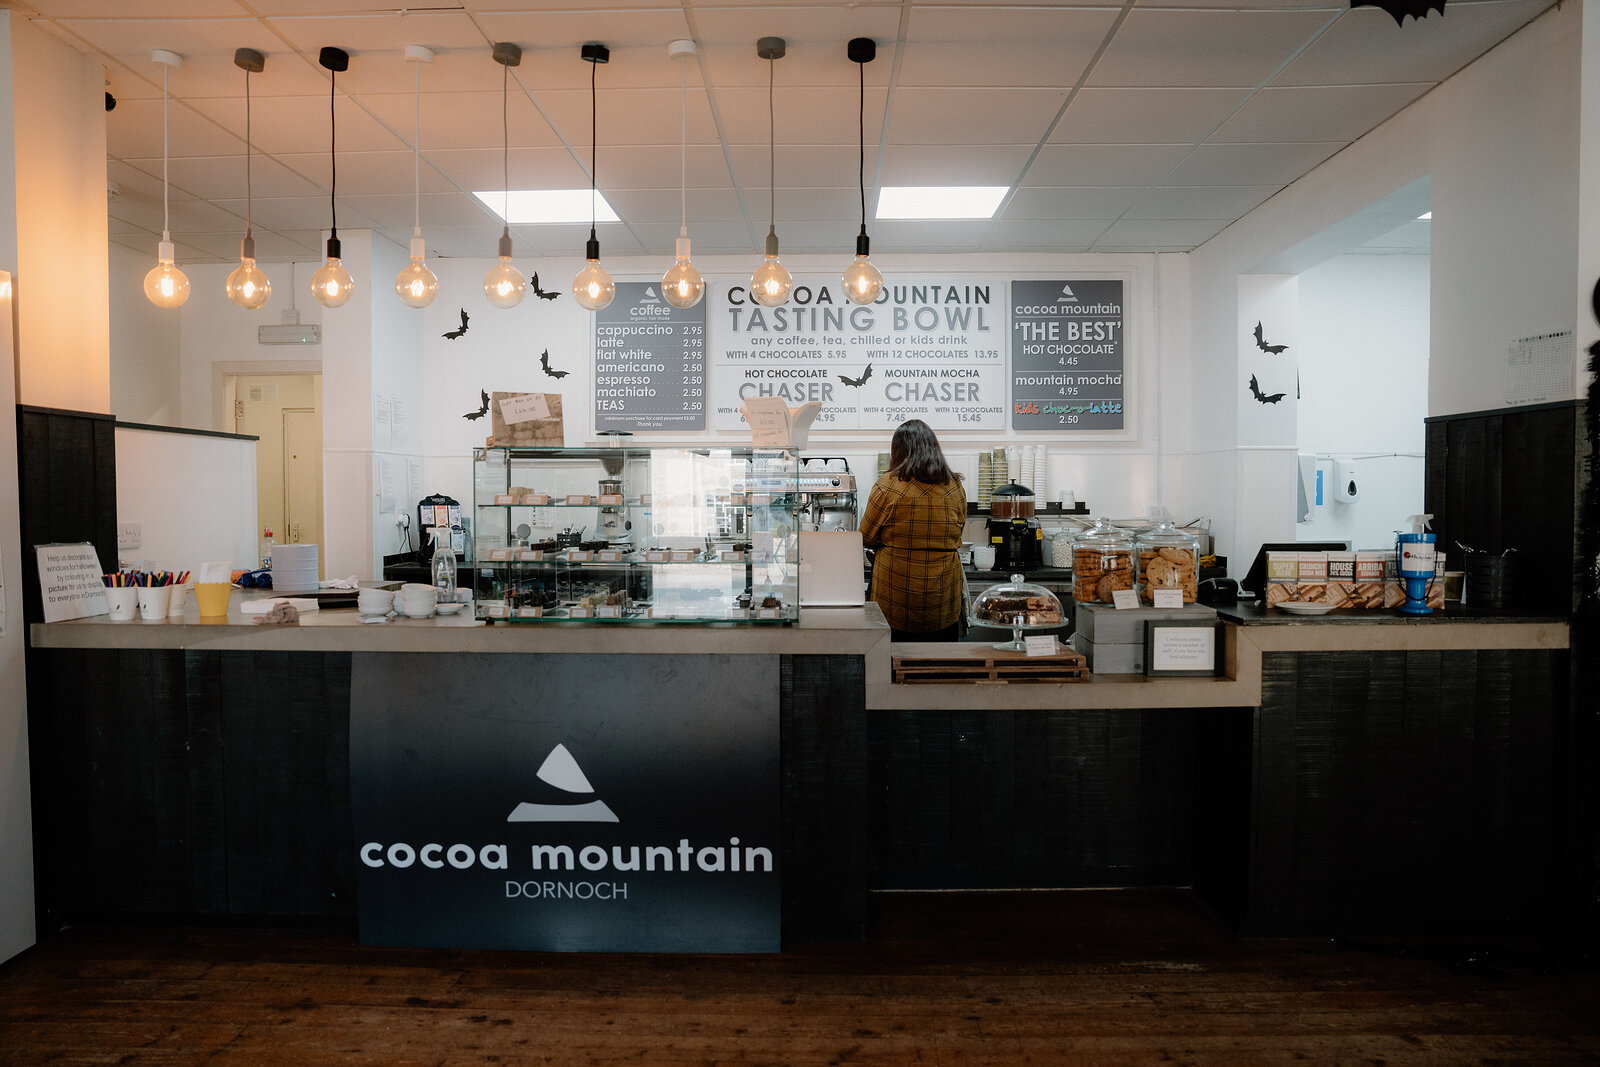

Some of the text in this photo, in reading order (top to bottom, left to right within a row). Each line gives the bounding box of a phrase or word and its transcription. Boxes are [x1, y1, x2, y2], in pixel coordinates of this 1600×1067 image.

[728, 286, 833, 305] COA
[630, 304, 670, 316] coffee
[1016, 303, 1120, 314] cocoa mountain
[729, 306, 989, 331] TASTING BOWL
[597, 324, 673, 337] cappuccino
[597, 337, 624, 347] latte
[751, 337, 772, 346] any
[777, 336, 818, 346] coffee,
[823, 336, 845, 346] tea,
[850, 336, 890, 344] chilled
[910, 336, 934, 344] kids
[938, 336, 968, 344] drink
[1023, 345, 1114, 354] HOT CHOCOLATE
[597, 350, 616, 360] flat
[620, 350, 652, 360] white
[597, 362, 702, 372] americano 2.50
[767, 370, 827, 378] CHOCOLATE
[597, 376, 702, 386] espresso 2.50
[1016, 375, 1121, 385] mountain mocha
[597, 387, 656, 397] machiato
[739, 382, 833, 401] CHASER
[885, 382, 979, 402] CHASER
[597, 400, 702, 410] TEAS 2.50
[1015, 401, 1122, 414] kids choc-o-latte
[1358, 563, 1383, 571] ARRIBA
[359, 836, 773, 872] cocoa mountain
[504, 880, 628, 899] DORNOCH
